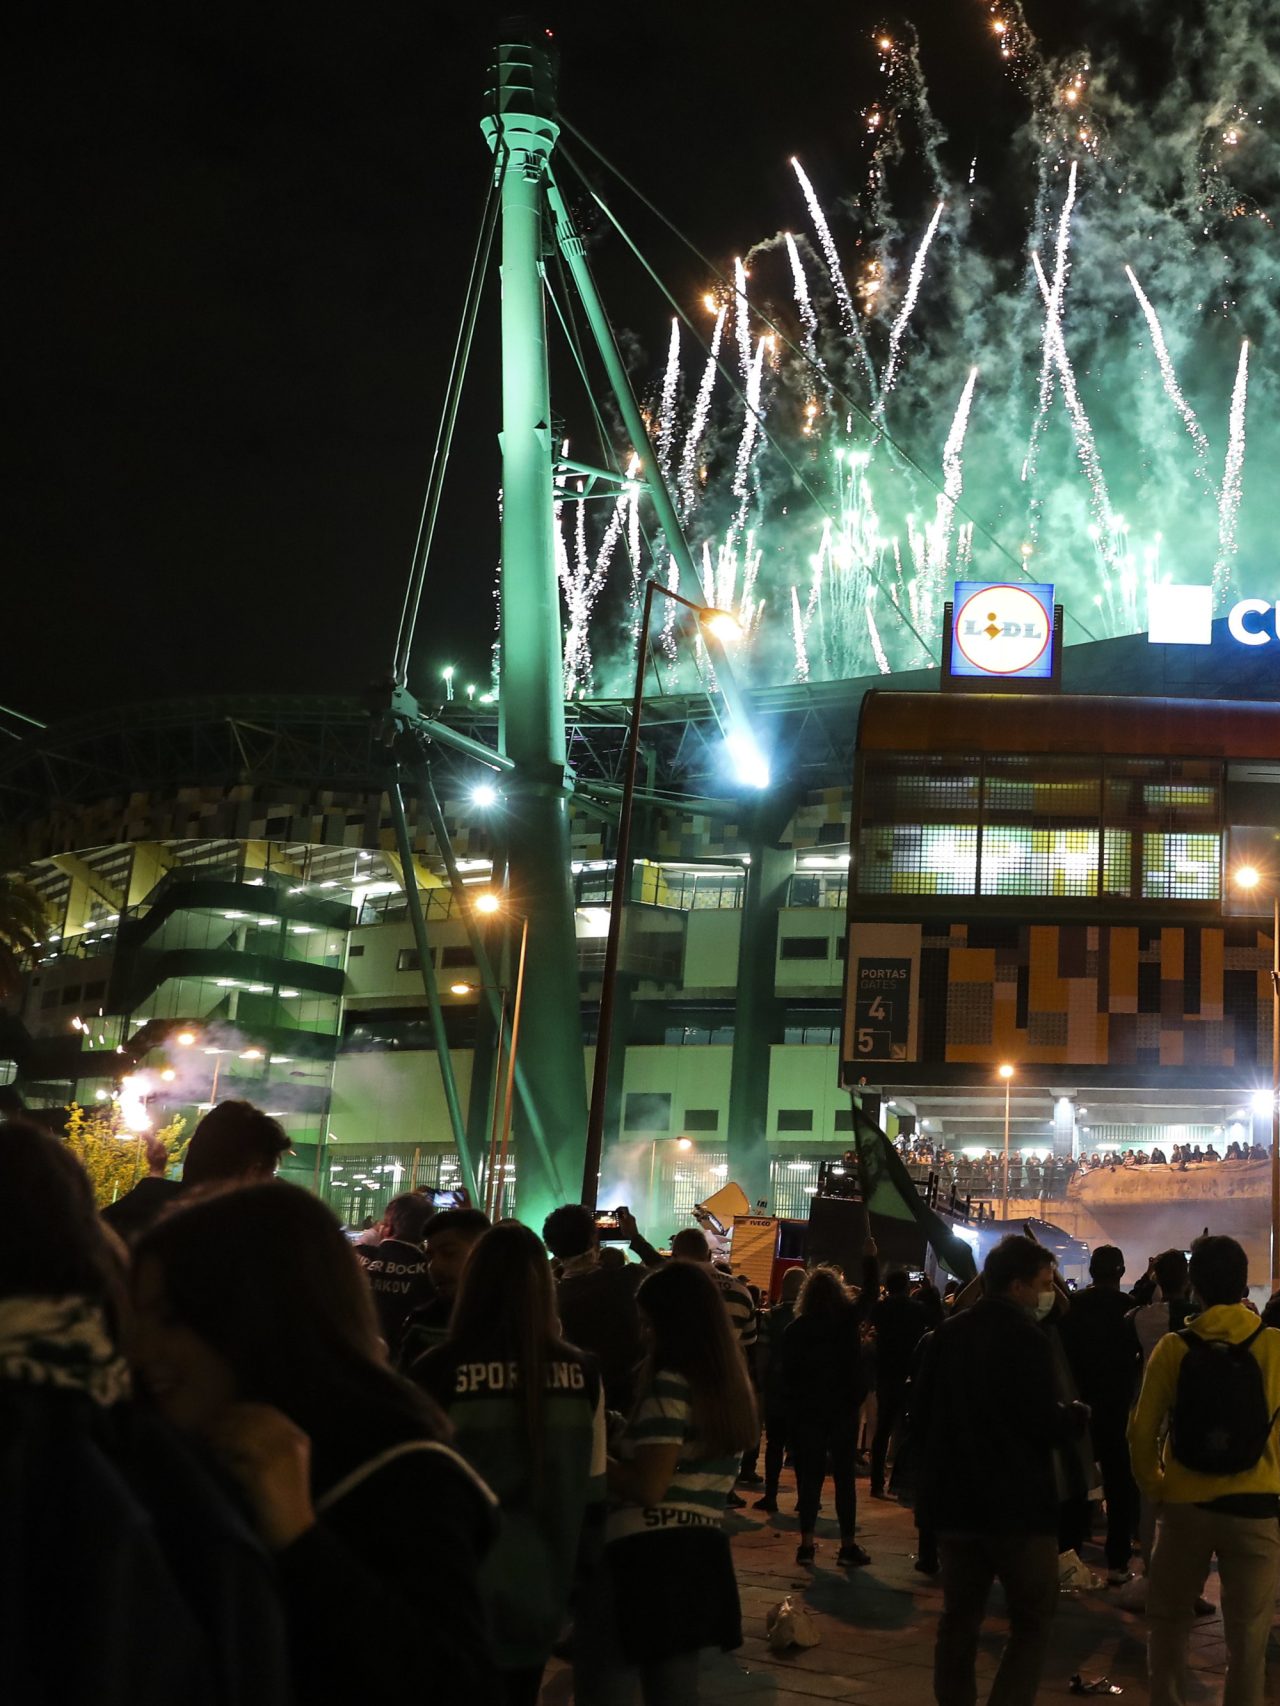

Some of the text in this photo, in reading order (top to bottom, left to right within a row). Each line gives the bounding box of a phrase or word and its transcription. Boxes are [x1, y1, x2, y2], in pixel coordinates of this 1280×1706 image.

[963, 612, 1042, 640] LIDL
[861, 969, 907, 979] PORTAS
[860, 980, 897, 989] GATES
[868, 996, 886, 1020] 4
[858, 1028, 874, 1053] 5
[385, 1261, 426, 1275] BOCK
